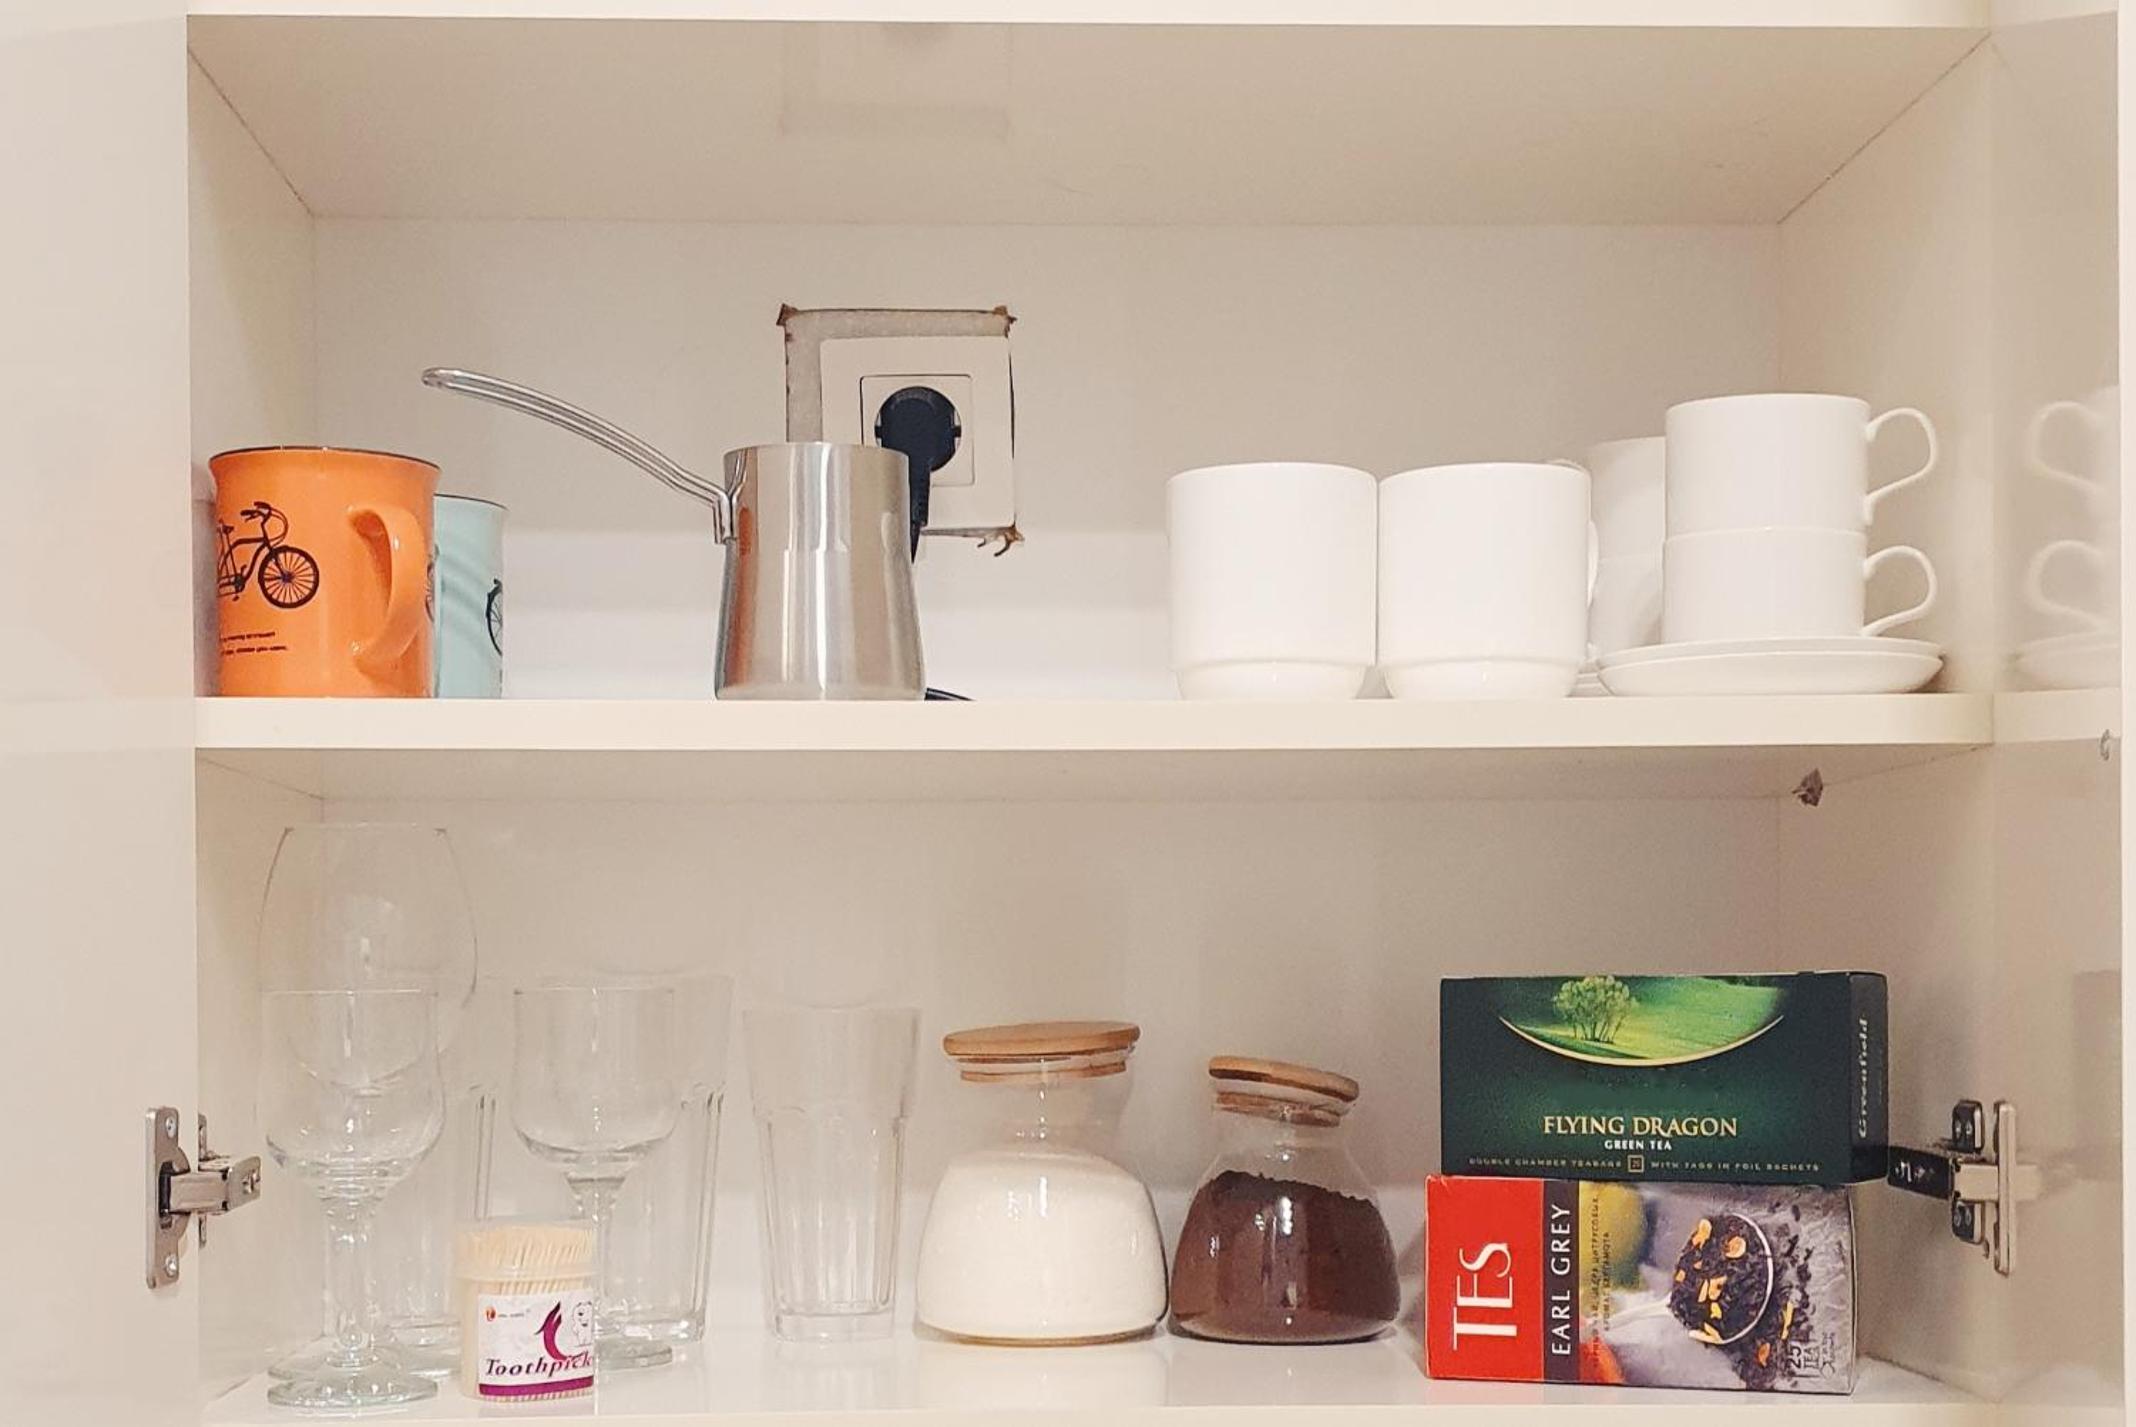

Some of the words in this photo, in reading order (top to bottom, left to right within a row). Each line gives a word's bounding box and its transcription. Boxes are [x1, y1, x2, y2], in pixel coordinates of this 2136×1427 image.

[1859, 1016, 1868, 1138] Greenfield
[1543, 1115, 1625, 1136] FLYING
[1632, 1116, 1737, 1138] DRAGON
[1604, 1139, 1645, 1150] GREEN
[1651, 1139, 1673, 1151] TEA
[1469, 1157, 1510, 1166] DOUBLE
[1515, 1158, 1567, 1167] CHAMBER
[1651, 1161, 1679, 1169] WITH
[1685, 1162, 1712, 1170] TAGS
[1735, 1163, 1761, 1171] FOIL
[1551, 1204, 1571, 1275] GREY
[1551, 1290, 1571, 1355] EARL
[1787, 1345, 1802, 1369] 25
